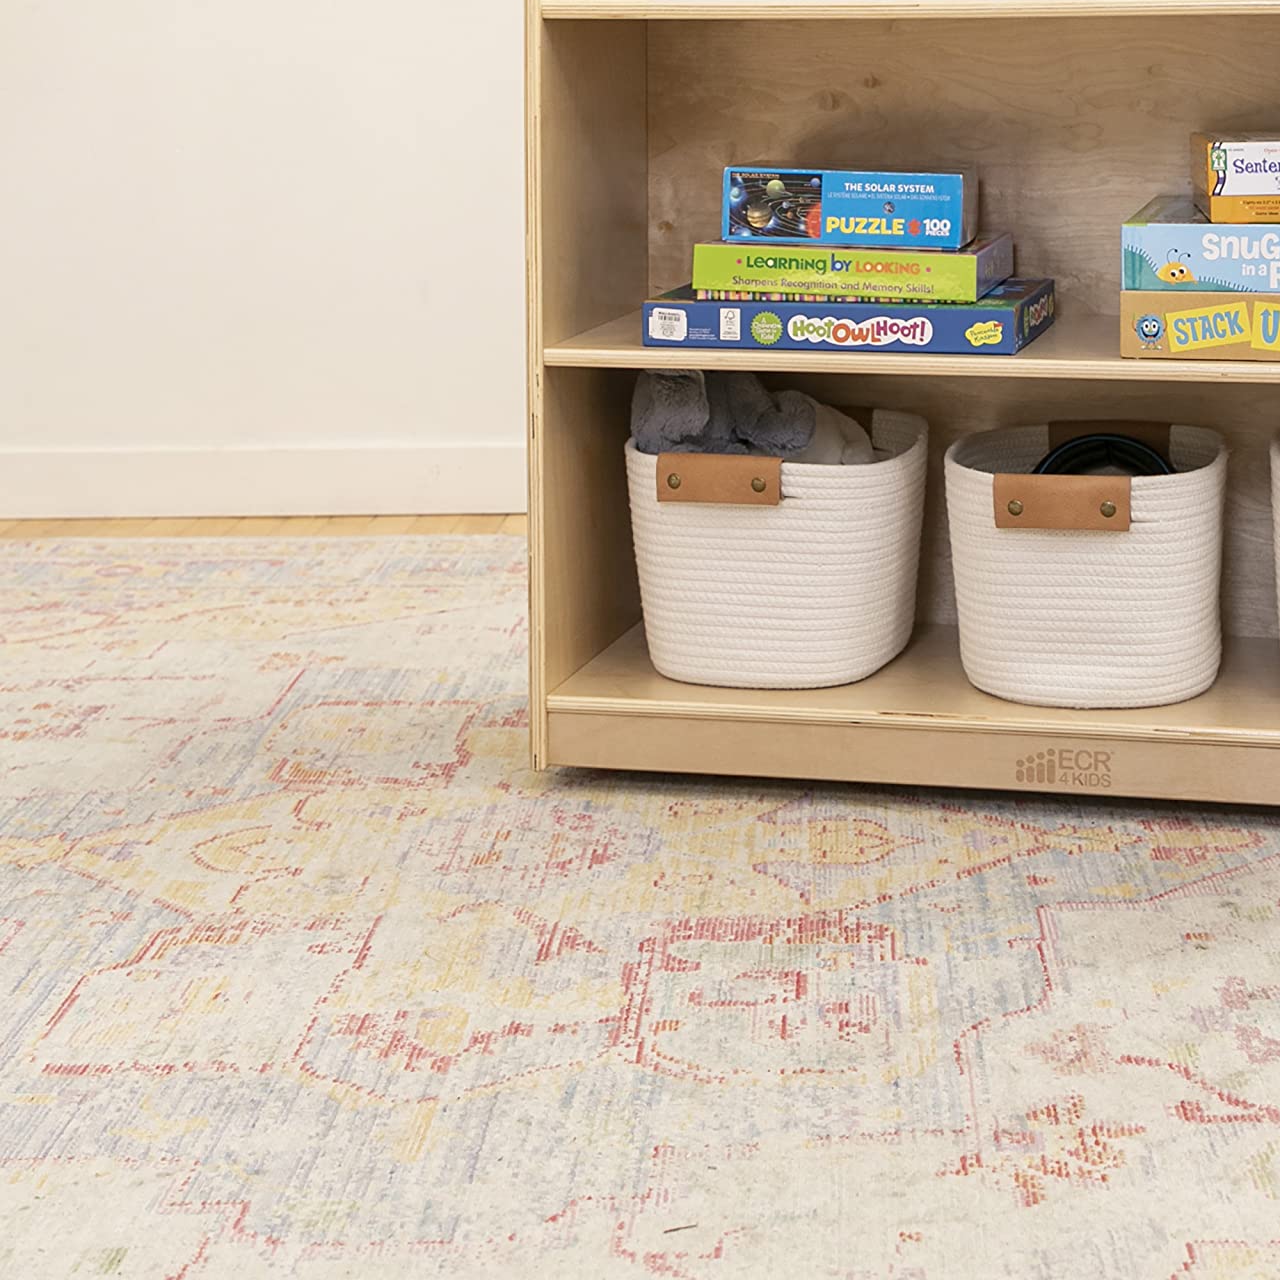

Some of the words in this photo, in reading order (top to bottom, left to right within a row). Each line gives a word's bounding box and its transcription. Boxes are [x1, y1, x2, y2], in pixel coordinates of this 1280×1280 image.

[844, 182, 863, 192] THE
[865, 183, 896, 192] SOLAR
[897, 184, 934, 193] SYSTEM
[826, 217, 905, 235] PUZZLE
[923, 218, 951, 231] 100
[855, 260, 920, 275] LOOKING
[1242, 263, 1255, 276] in
[1258, 264, 1267, 276] a
[732, 276, 778, 287] Sharpens
[781, 278, 838, 290] Recognition
[841, 281, 859, 290] and
[862, 282, 903, 294] Memory
[906, 283, 934, 294] Skills!
[1173, 310, 1244, 345] STACK
[1058, 749, 1111, 772] ECR
[1059, 772, 1069, 784] 4
[1072, 772, 1111, 788] KIDS
